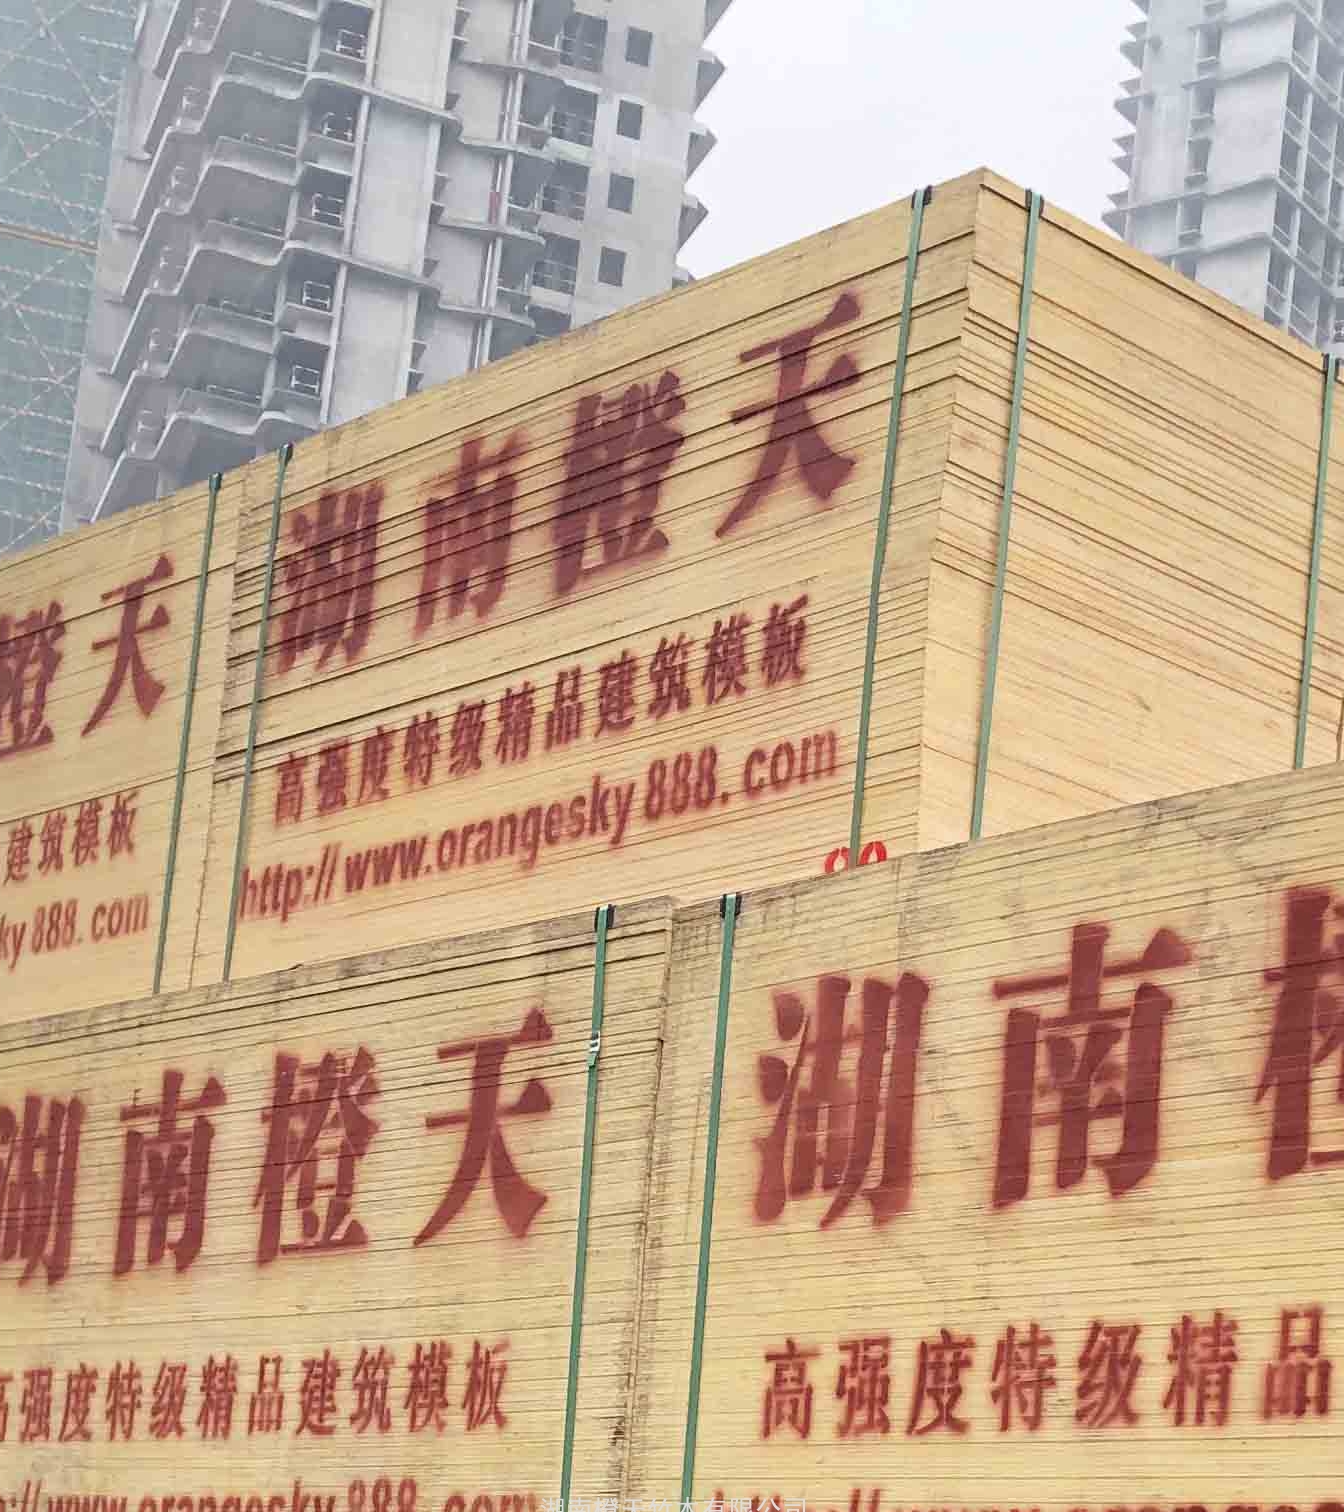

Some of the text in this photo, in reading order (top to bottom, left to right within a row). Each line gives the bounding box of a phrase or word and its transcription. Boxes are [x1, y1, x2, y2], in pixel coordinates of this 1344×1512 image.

[270, 288, 864, 677] 湖南橙天
[273, 593, 807, 824] 高强度特级精品建筑模板
